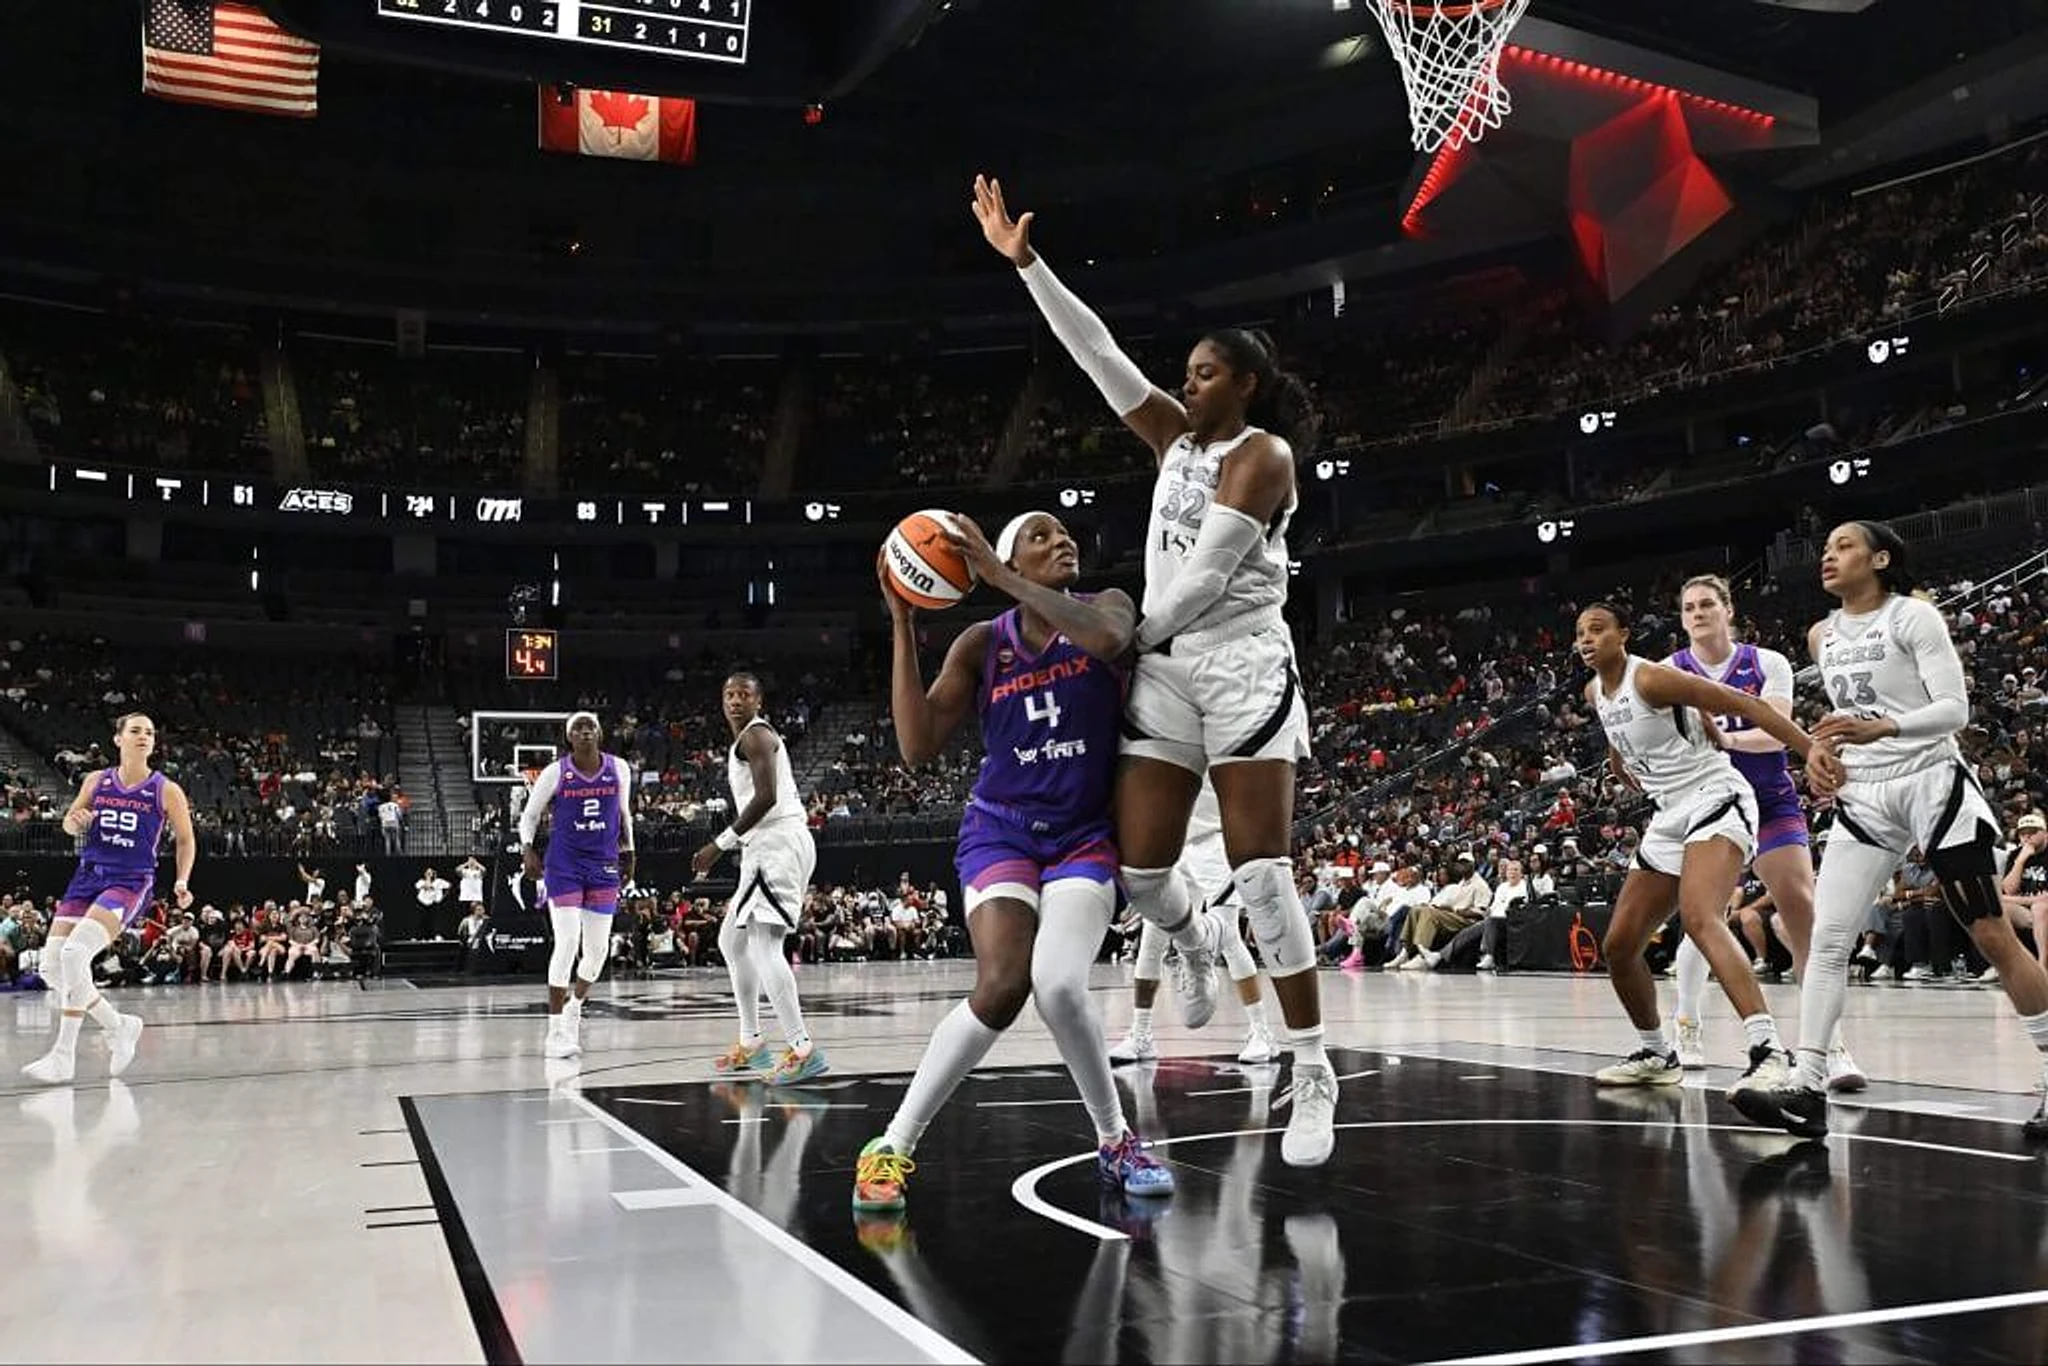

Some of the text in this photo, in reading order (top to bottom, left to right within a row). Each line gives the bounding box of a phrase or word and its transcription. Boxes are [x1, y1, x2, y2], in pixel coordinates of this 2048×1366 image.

[444, 0, 554, 26] 2 4 0 2
[731, 1, 739, 17] 1
[592, 16, 738, 51] 31 2 1 1 0
[281, 489, 352, 513] ACES
[889, 540, 935, 594] Wilson
[521, 634, 551, 649] 7:34
[991, 655, 1089, 703] PHOENIX
[1831, 671, 1877, 709] 23
[1024, 691, 1061, 728] 4
[100, 809, 138, 832] 29
[583, 798, 601, 817] 2
